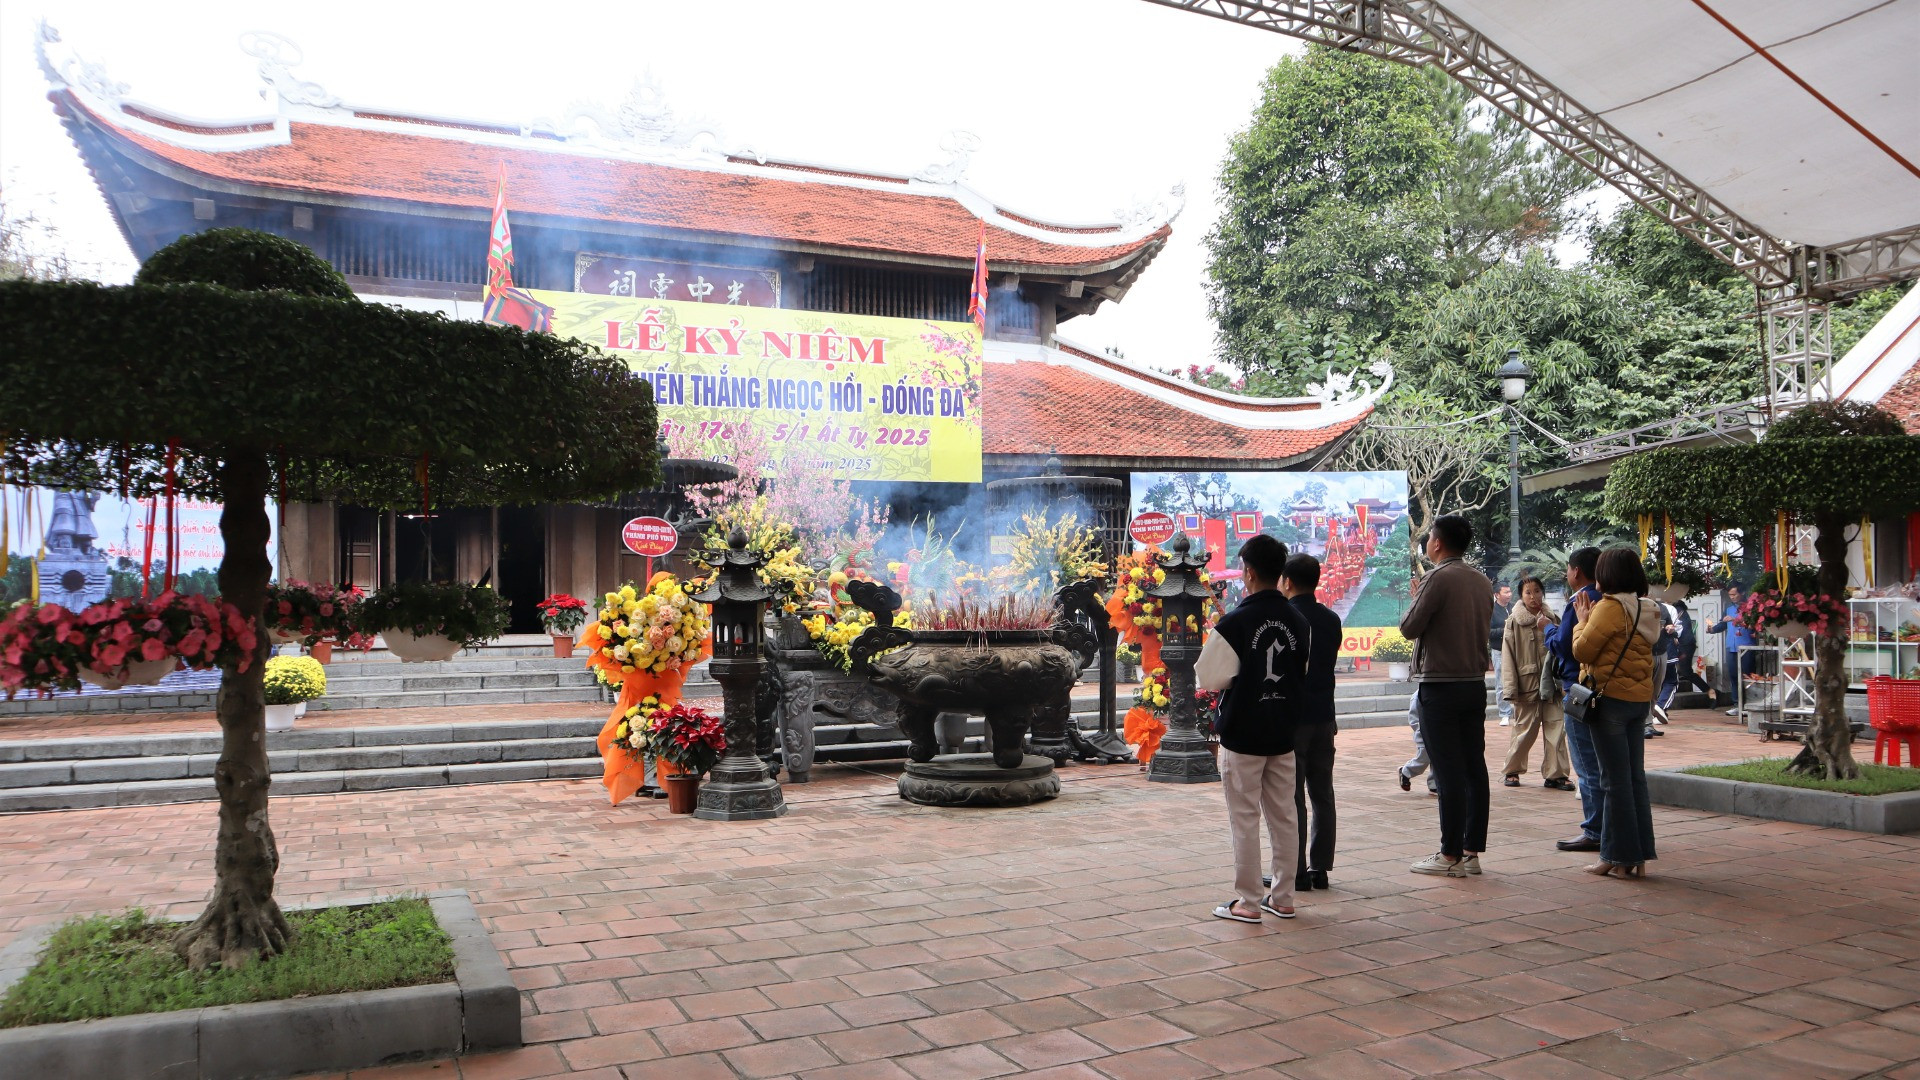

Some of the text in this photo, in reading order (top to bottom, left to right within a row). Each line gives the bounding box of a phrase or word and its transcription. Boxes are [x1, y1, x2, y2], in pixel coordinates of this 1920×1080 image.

[604, 309, 888, 371] LỄ KỶ NIỆM
[690, 364, 761, 409] THẮNG
[767, 378, 823, 417] NGỌC
[829, 372, 862, 413] HỒI
[882, 375, 934, 416] ĐỐNG
[940, 388, 965, 417] ĐA
[772, 422, 809, 443] 5/1
[875, 427, 930, 446] 2025
[838, 457, 872, 471] 2025
